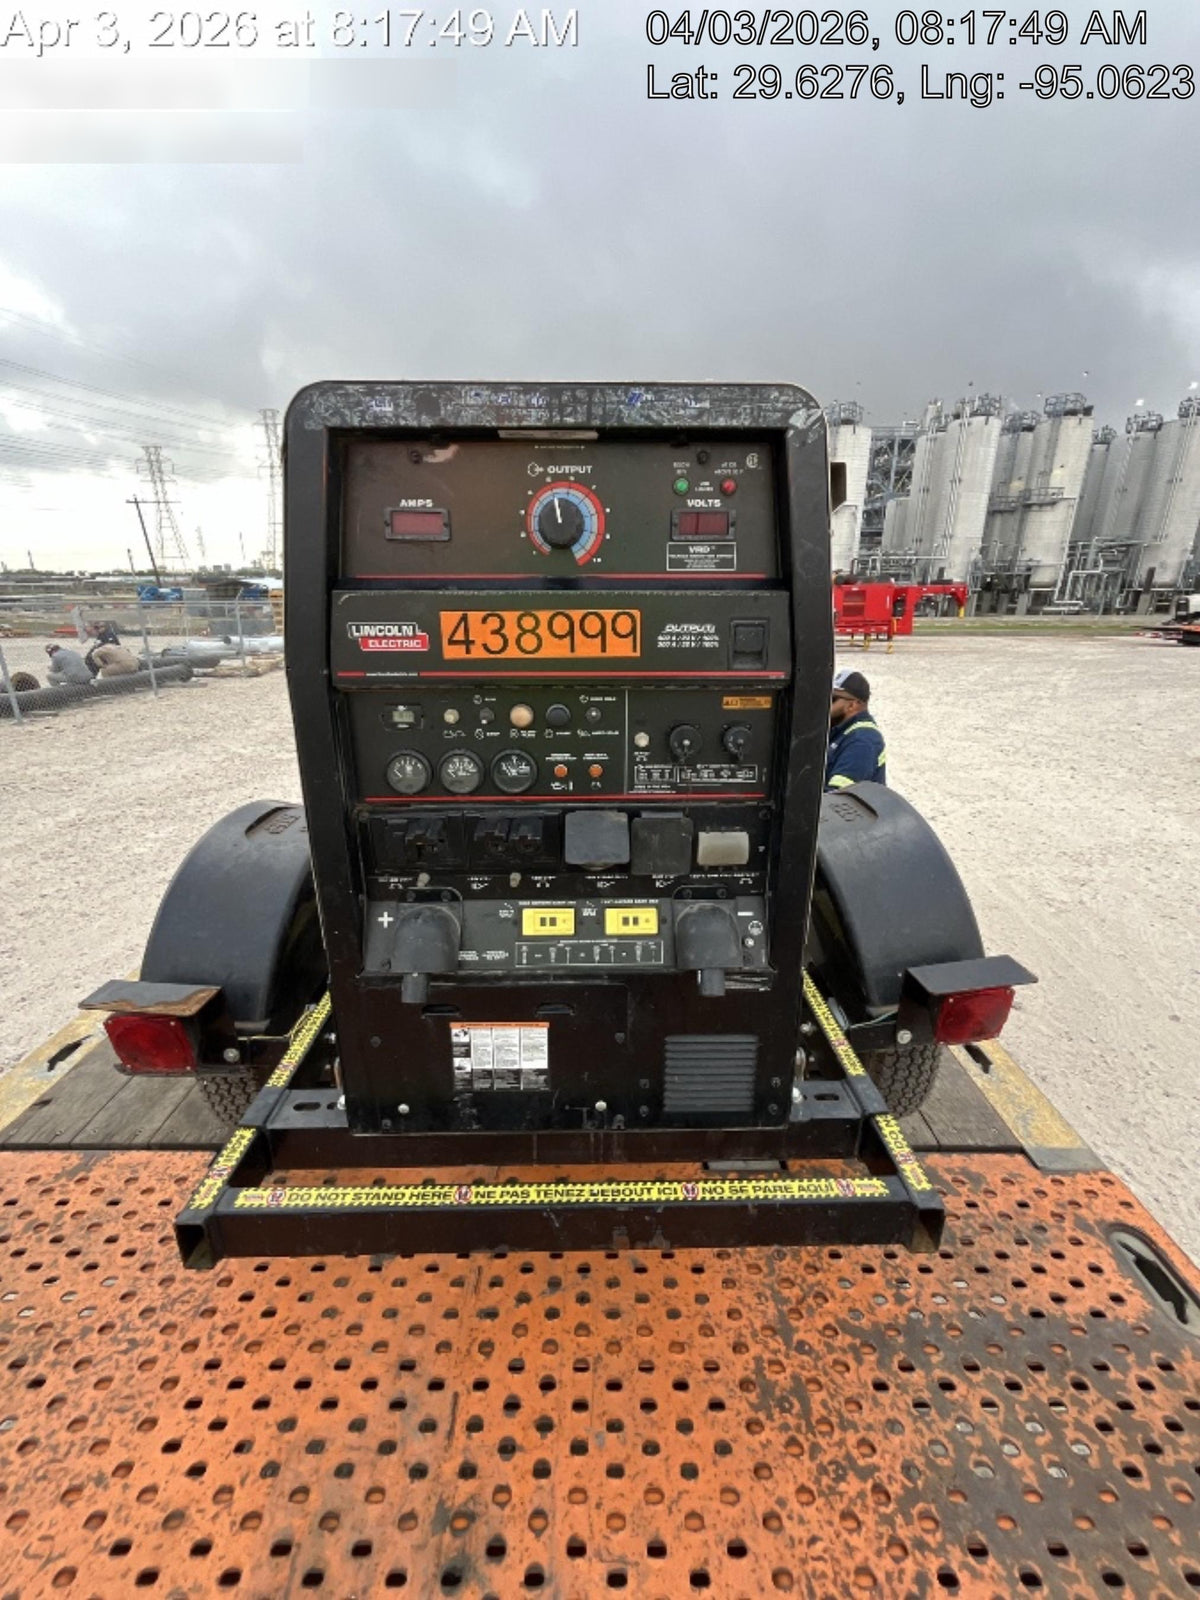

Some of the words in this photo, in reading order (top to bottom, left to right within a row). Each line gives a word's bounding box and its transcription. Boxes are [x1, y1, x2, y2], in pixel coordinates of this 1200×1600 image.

[547, 465, 593, 474] OUTPUT
[400, 499, 433, 508] AMPS
[687, 499, 722, 508] VOLTS
[351, 625, 414, 637] LINCOLN
[447, 611, 637, 655] 438999
[368, 639, 422, 648] ELECTRIC
[288, 1192, 312, 1202] DO
[315, 1192, 351, 1201] NOT
[351, 1191, 406, 1201] STAND
[409, 1190, 454, 1200] HERE
[474, 1190, 497, 1199] NE
[500, 1190, 530, 1199] PAS
[535, 1188, 586, 1198] TENEZ
[657, 1187, 679, 1196] ICI
[702, 1186, 726, 1196] NO
[753, 1185, 795, 1195] PARE
